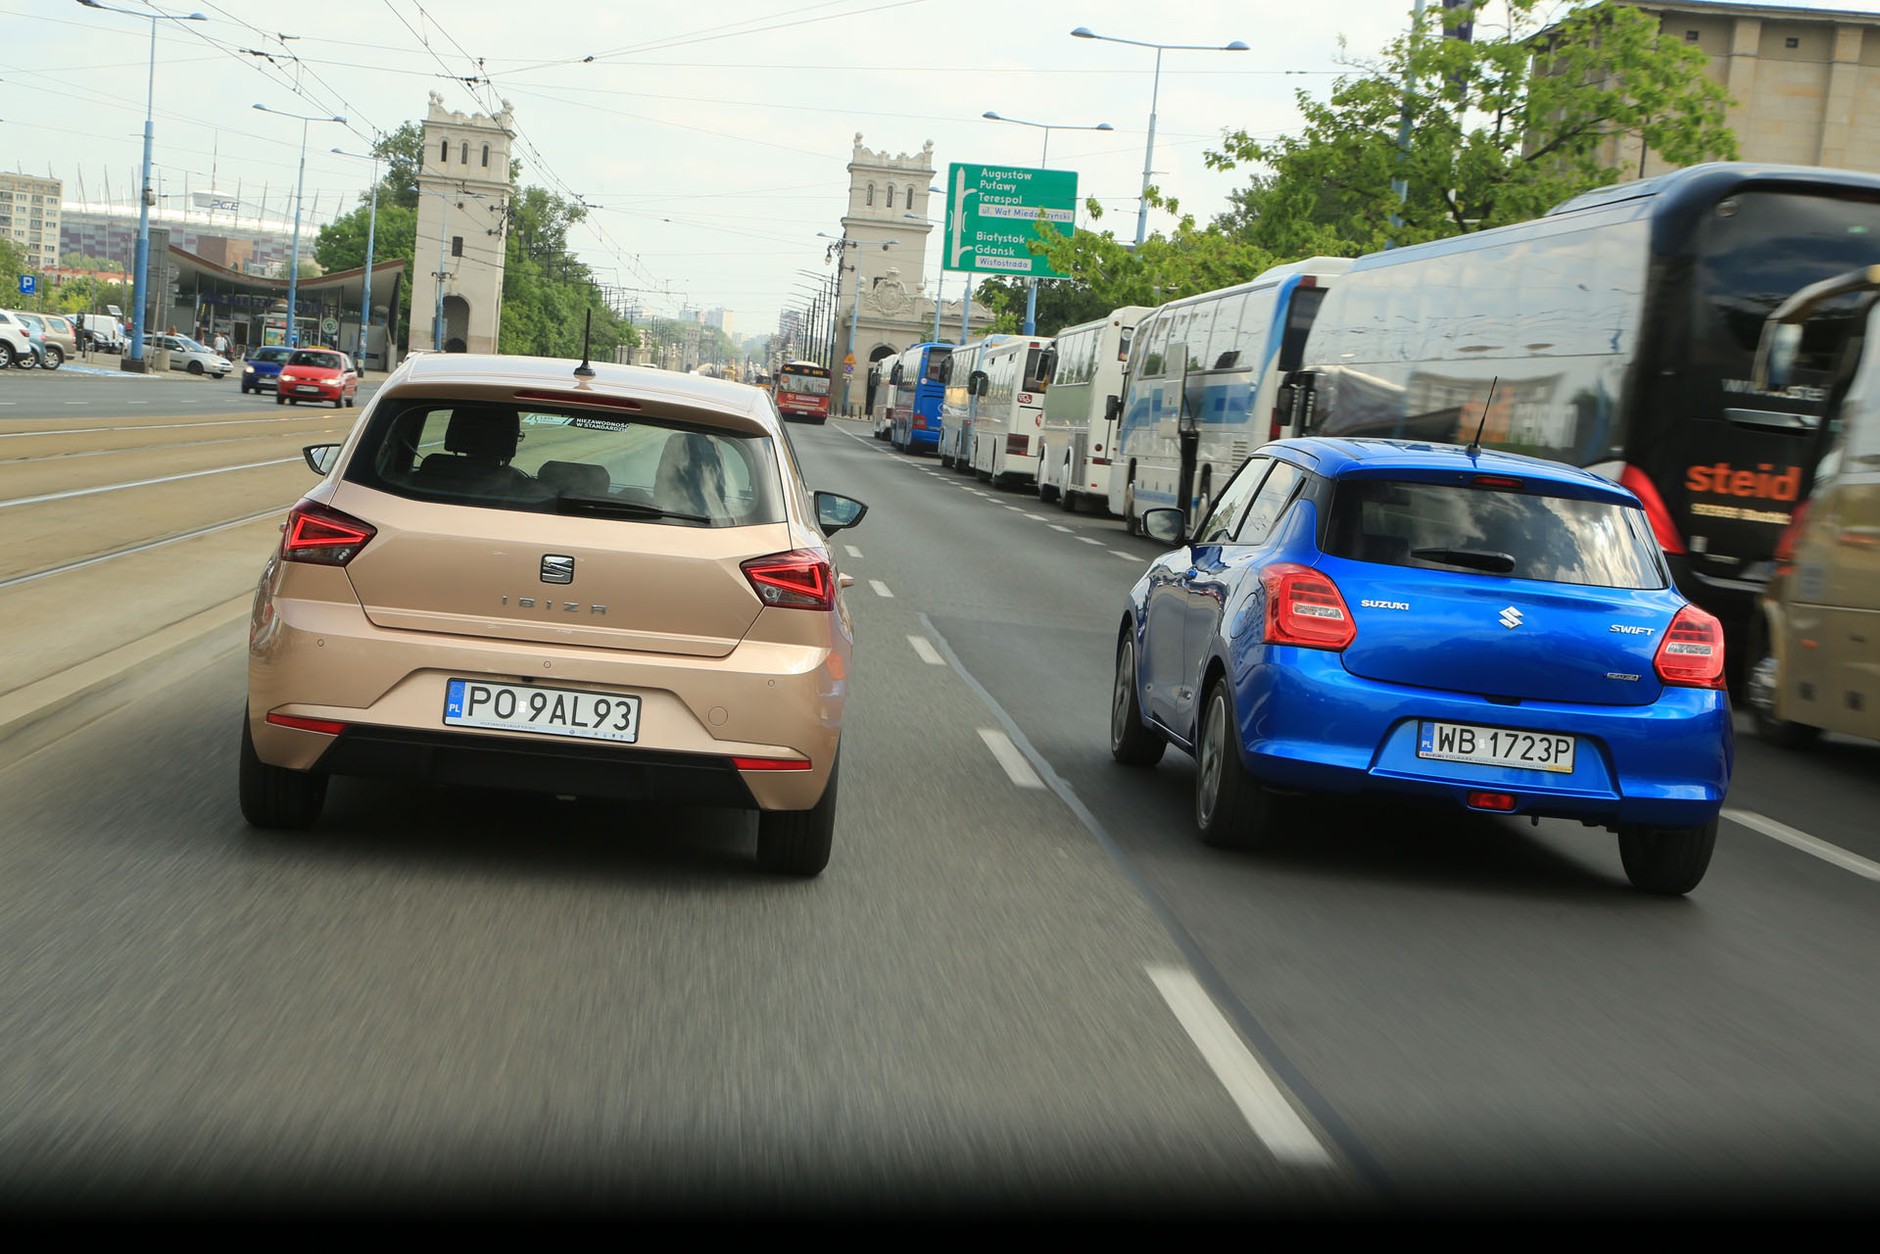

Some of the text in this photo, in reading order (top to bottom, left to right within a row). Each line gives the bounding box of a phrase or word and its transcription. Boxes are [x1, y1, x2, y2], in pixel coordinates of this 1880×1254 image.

[981, 167, 1032, 180] Augustów
[980, 180, 1016, 193] Puławy
[979, 192, 1022, 205] Terespol
[995, 207, 1011, 216] Wał
[1014, 208, 1071, 220] Miedzzyński
[976, 231, 1025, 245] Białystok
[975, 244, 1015, 256] Gdańsk
[980, 257, 1028, 268] Wisłostrada
[23, 276, 33, 288] P
[1684, 462, 1802, 500] steid
[502, 595, 607, 615] IBIZA
[1361, 599, 1410, 610] SUZUKI
[1609, 624, 1656, 636] SWIFT
[449, 704, 460, 713] PL
[468, 686, 632, 731] PO 9AL93
[1422, 740, 1431, 748] PL
[1438, 726, 1476, 754] WB
[1490, 732, 1570, 763] 1723P
